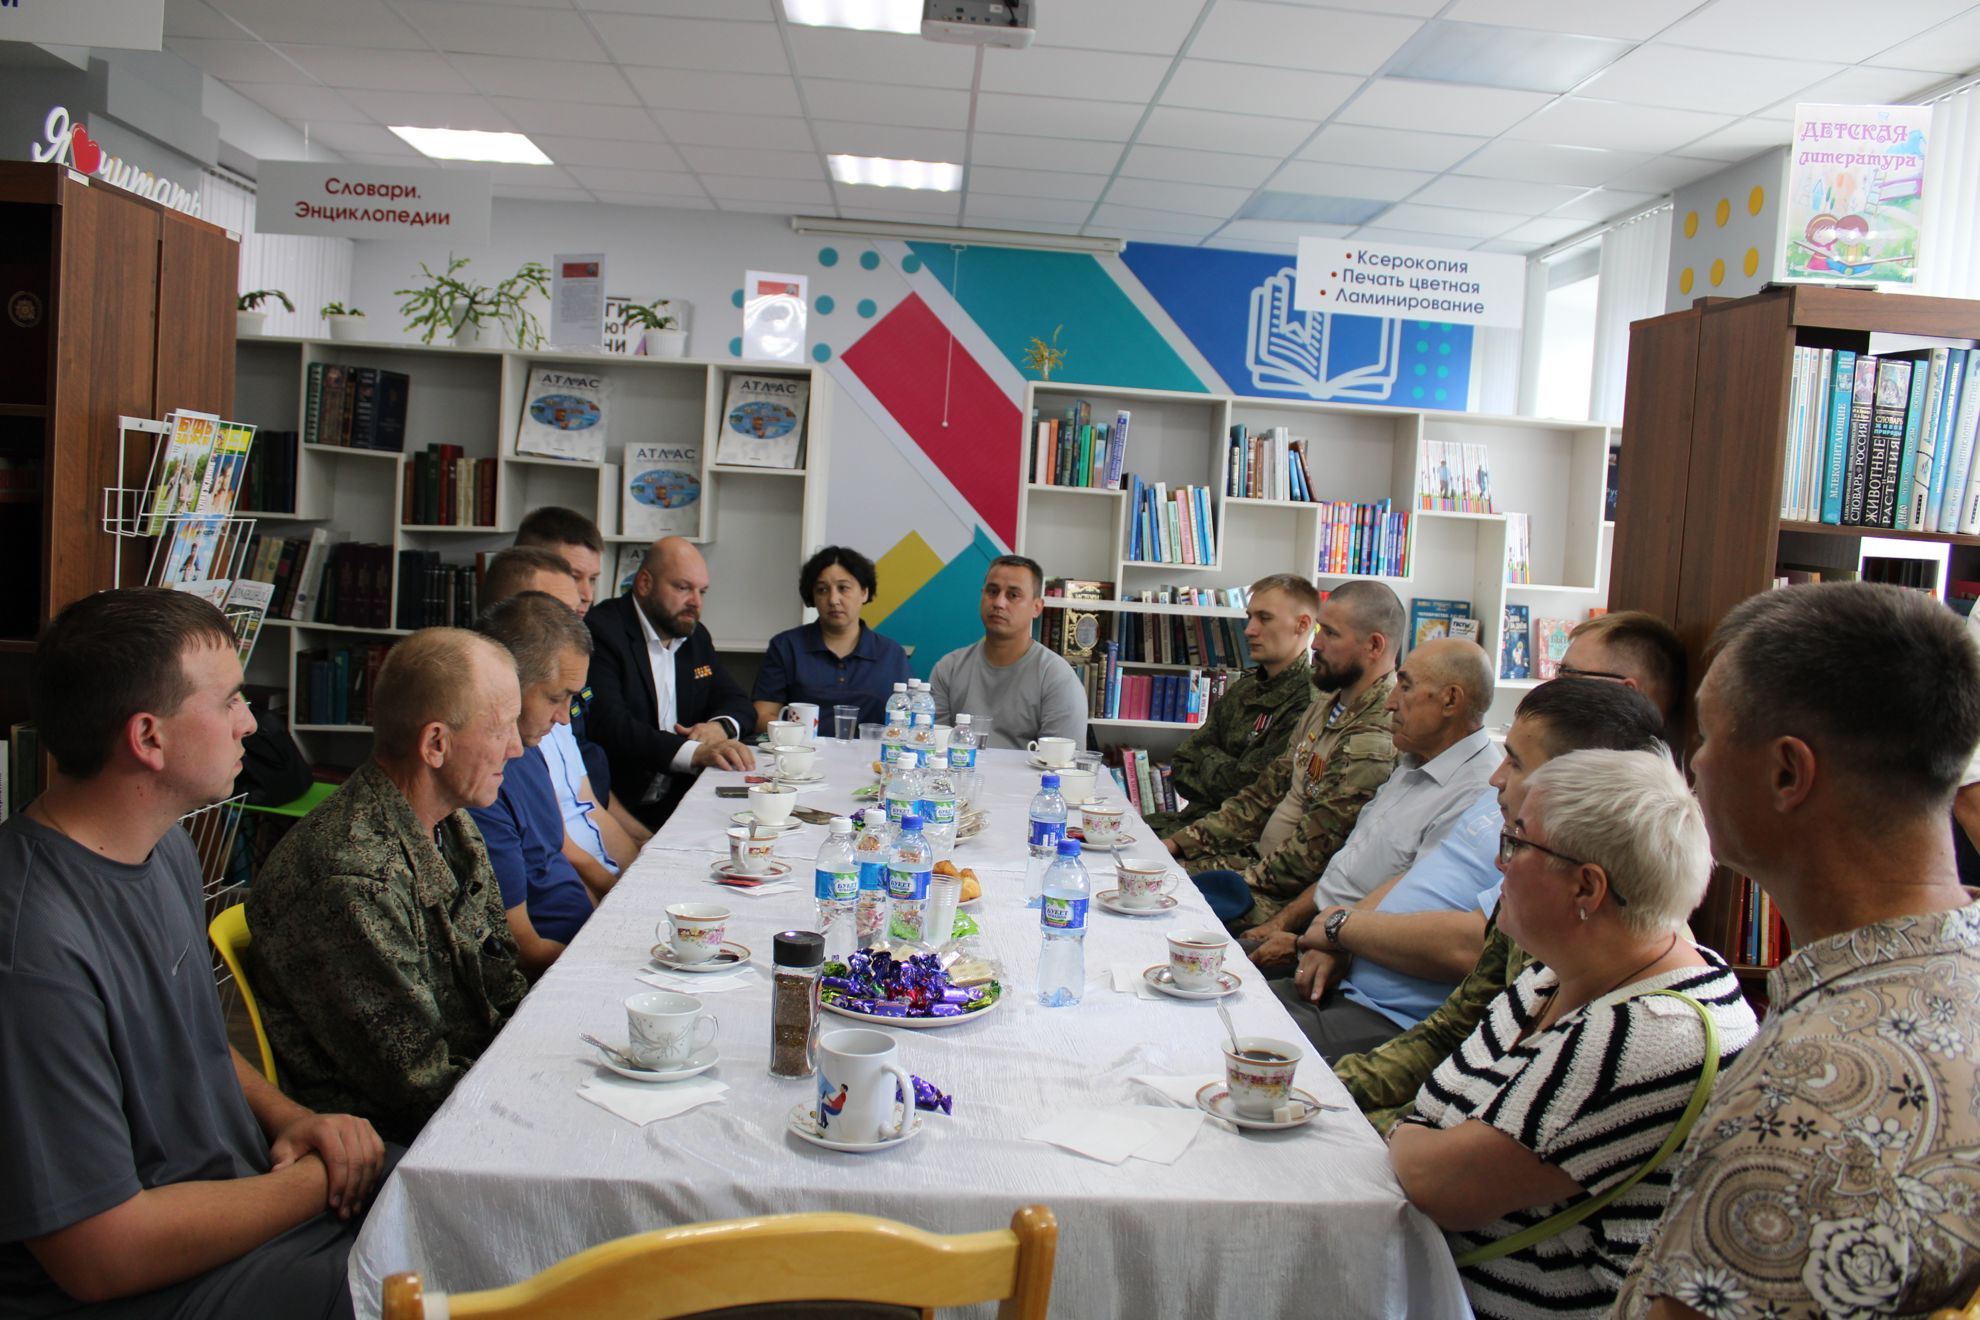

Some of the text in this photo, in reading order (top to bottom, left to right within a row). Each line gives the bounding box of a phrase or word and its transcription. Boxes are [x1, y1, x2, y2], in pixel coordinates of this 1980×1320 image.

[1800, 121, 1908, 143] ДЕТСКАЯ
[1799, 151, 1916, 169] литература
[99, 150, 202, 216] читать
[325, 178, 421, 200] Словари.
[295, 201, 450, 226] Энциклопедии
[1357, 250, 1469, 273] Ксерокопия
[1343, 268, 1481, 294] Печать цветная
[1335, 288, 1485, 314] Ламинирование
[1829, 402, 1847, 499] МЛЕКОПИТАЮЩИЕ
[1855, 422, 1868, 466] РОССИЯ
[1865, 438, 1886, 523] ЖИВОТНЫЕ
[1882, 440, 1900, 524] РАСТЕНИЯ
[1851, 473, 1863, 521] СЛОВАРЬ
